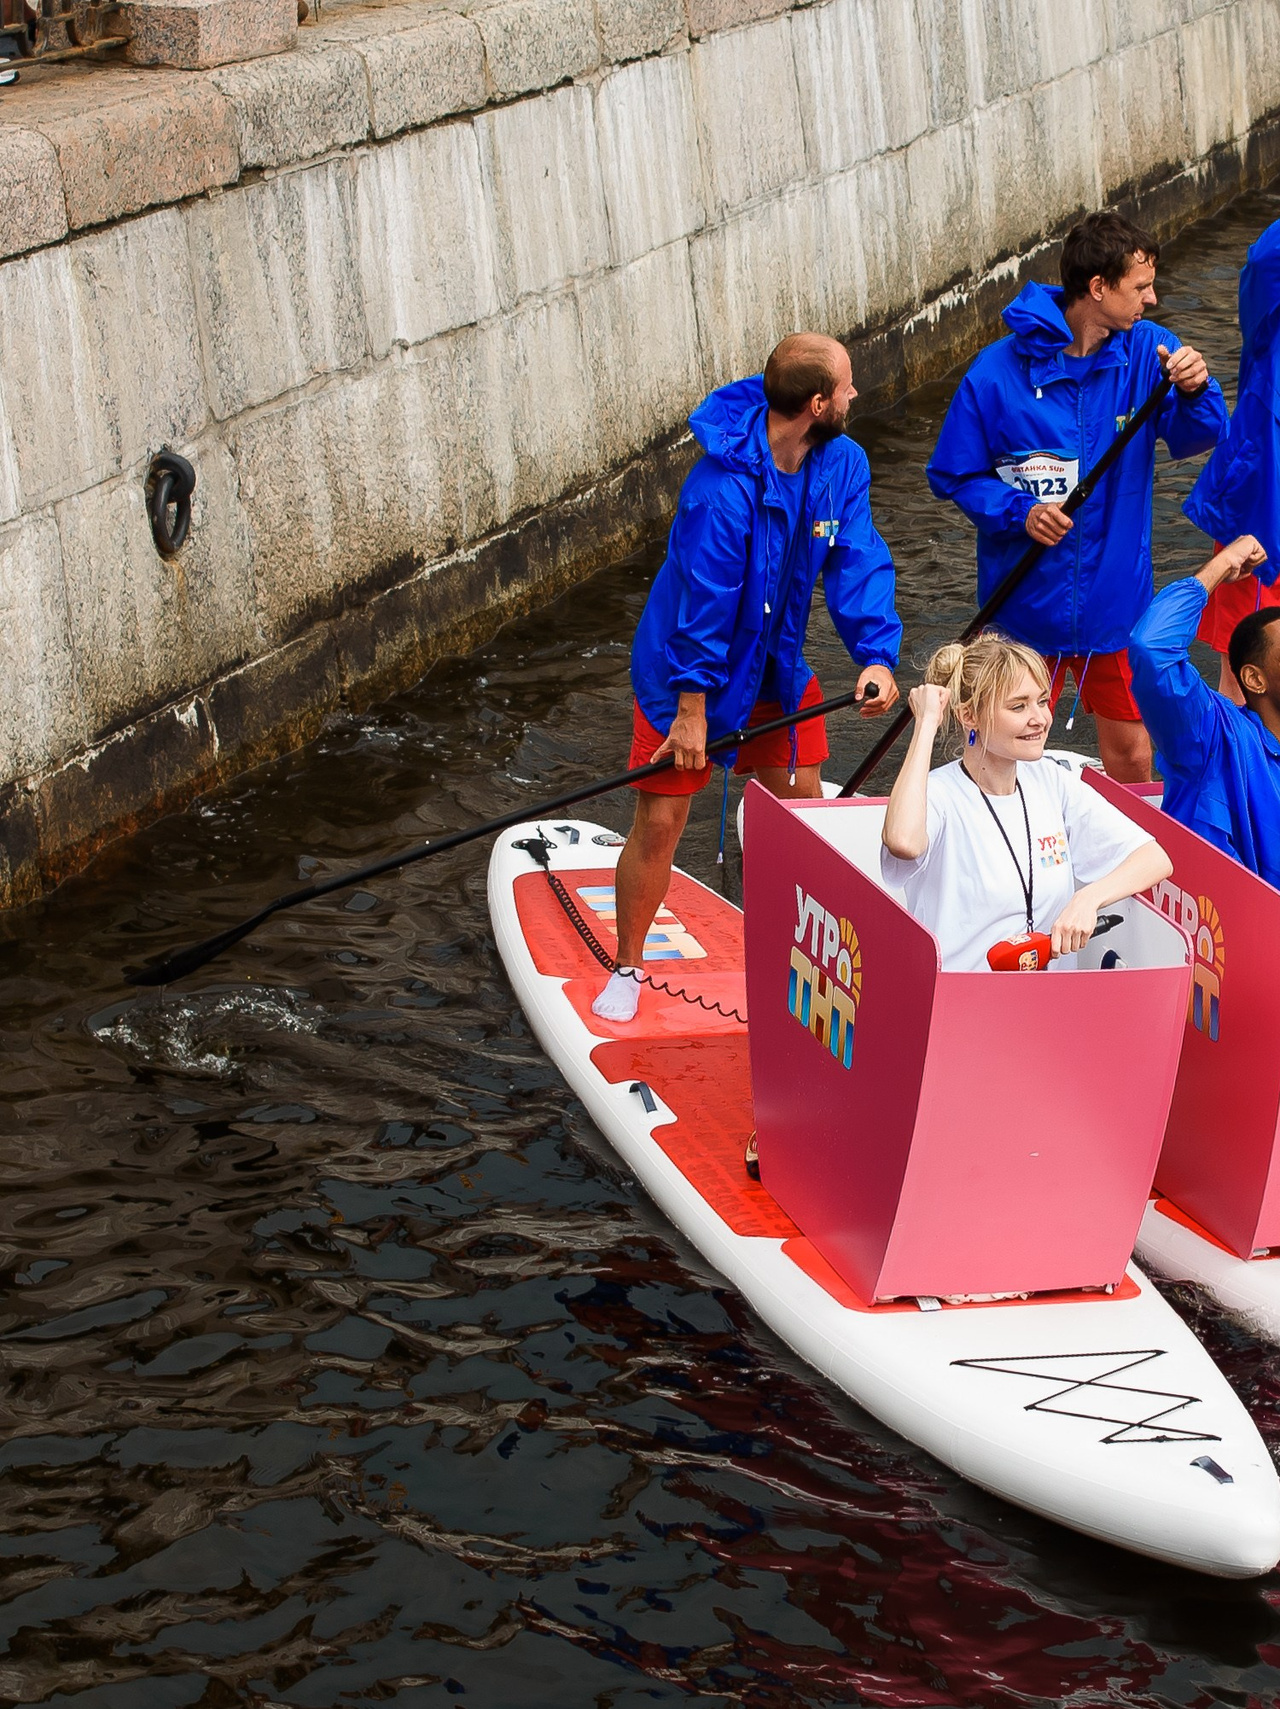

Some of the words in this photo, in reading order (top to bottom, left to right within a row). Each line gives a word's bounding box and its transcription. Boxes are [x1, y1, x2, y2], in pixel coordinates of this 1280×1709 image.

[1049, 465, 1065, 474] SUP
[794, 883, 853, 989] УТРО
[788, 945, 856, 1071] ТНТ
